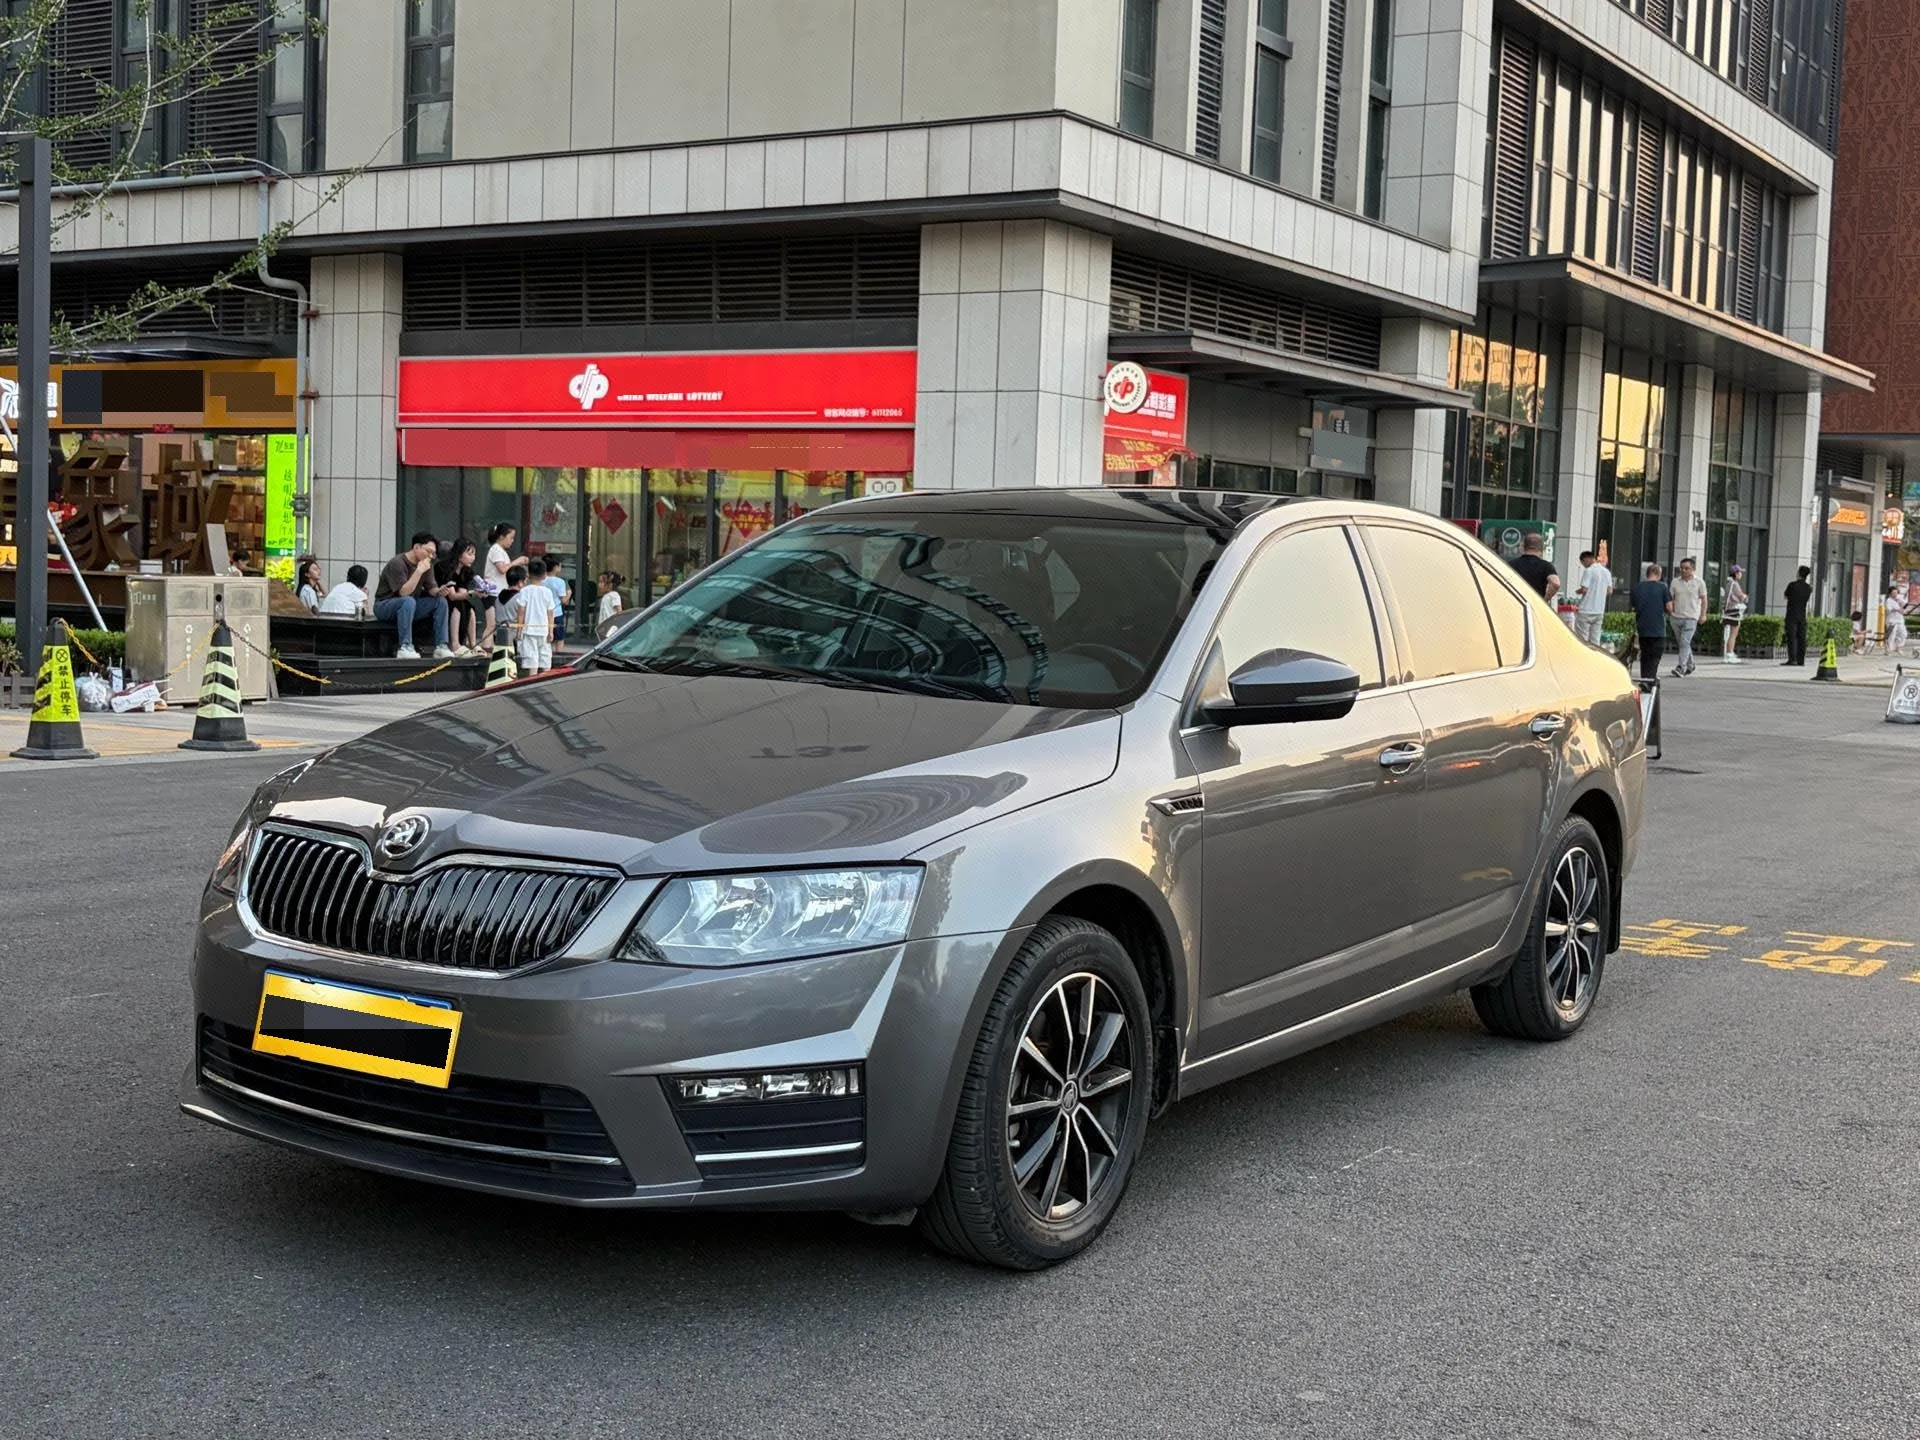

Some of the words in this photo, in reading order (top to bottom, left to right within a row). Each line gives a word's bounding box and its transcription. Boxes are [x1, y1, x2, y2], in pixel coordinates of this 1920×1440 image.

[686, 391, 724, 401] LOTTERY
[58, 665, 73, 716] 禁止停车
[1056, 943, 1089, 965] ENERGY
